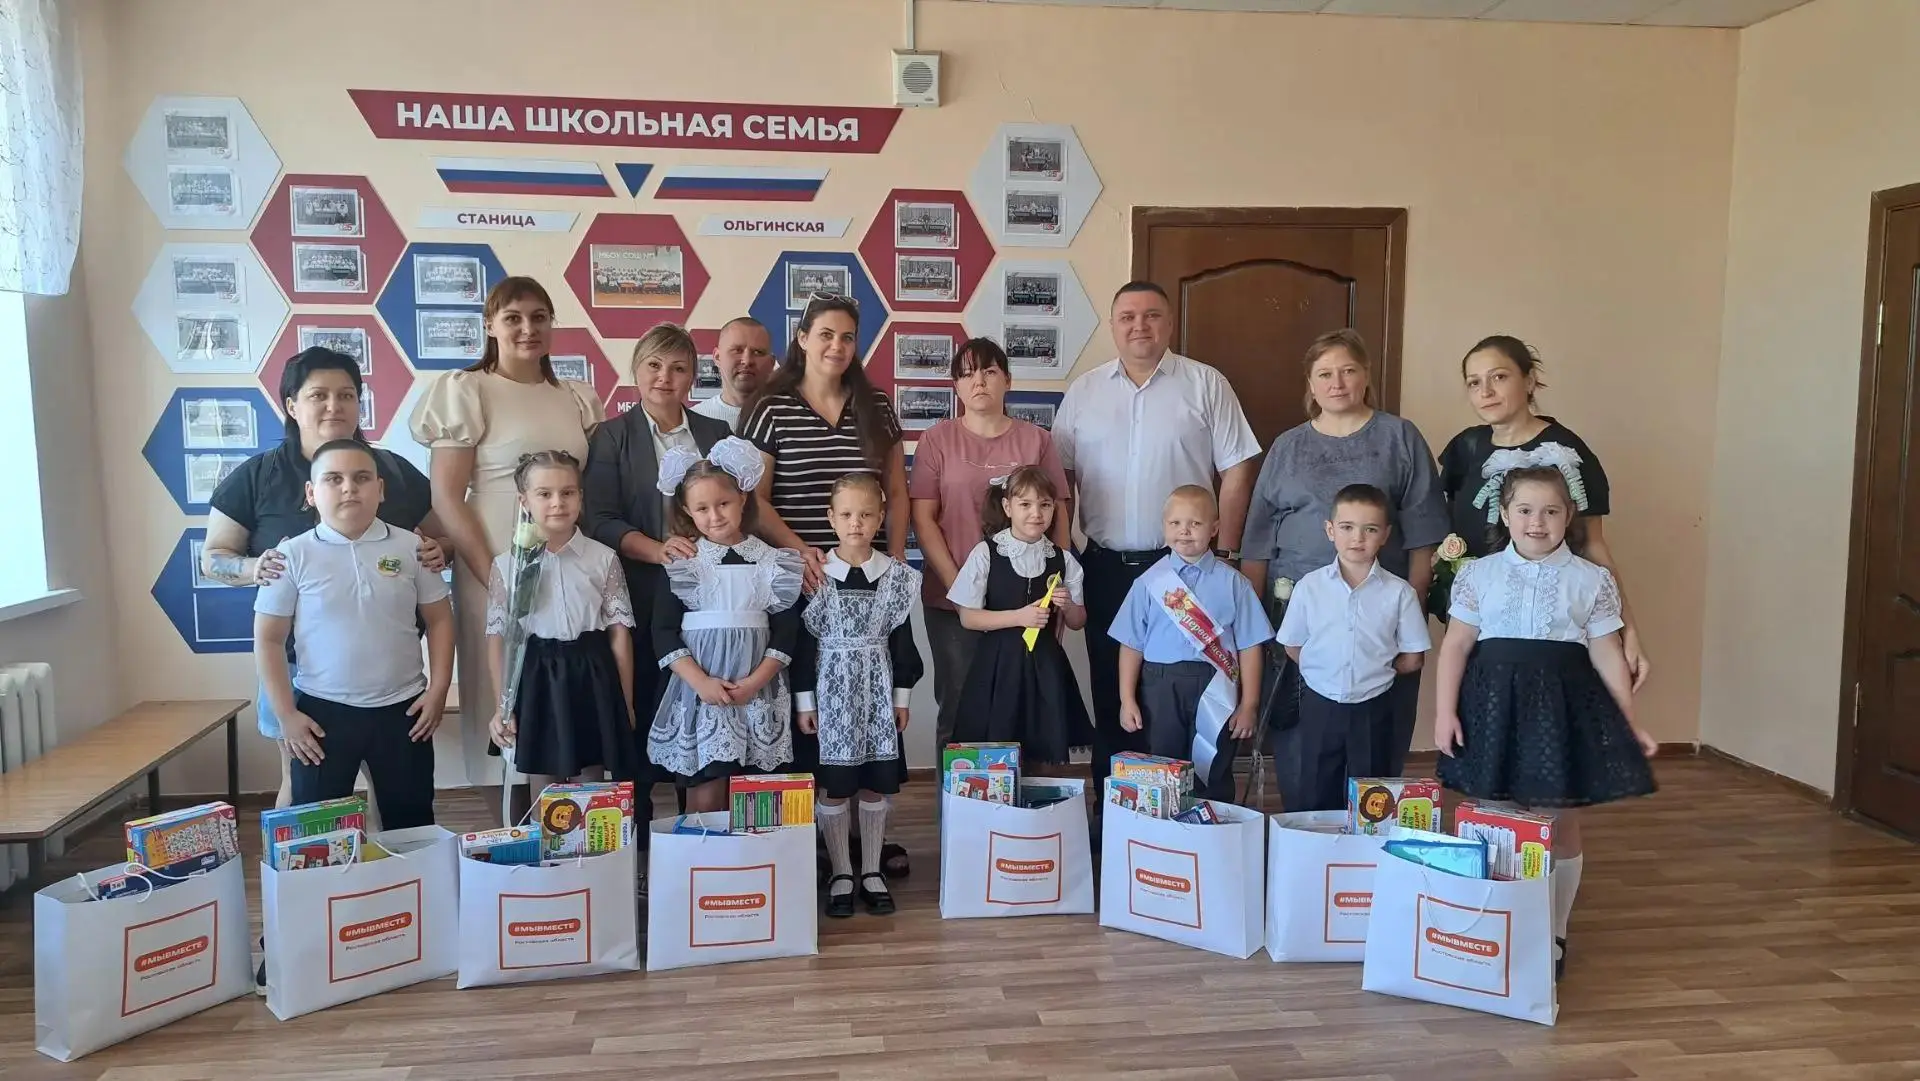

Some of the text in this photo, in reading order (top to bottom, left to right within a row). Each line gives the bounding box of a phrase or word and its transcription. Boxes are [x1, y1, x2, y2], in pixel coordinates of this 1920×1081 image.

[397, 103, 859, 141] НАША ШКОЛЬНАЯ СЕМЬЯ
[457, 213, 536, 227] СТАНИЦА
[724, 219, 825, 233] ОЛЬГИНСКАЯ
[704, 898, 761, 907] #МЫВМЕСТЕ
[345, 917, 406, 937] #МЫВМЕСТЕ
[514, 923, 575, 932] #МЫВМЕСТЕ
[1431, 932, 1493, 953] #МЫВМЕСТЕ
[141, 941, 203, 966] #МЫВМЕСТЕ
